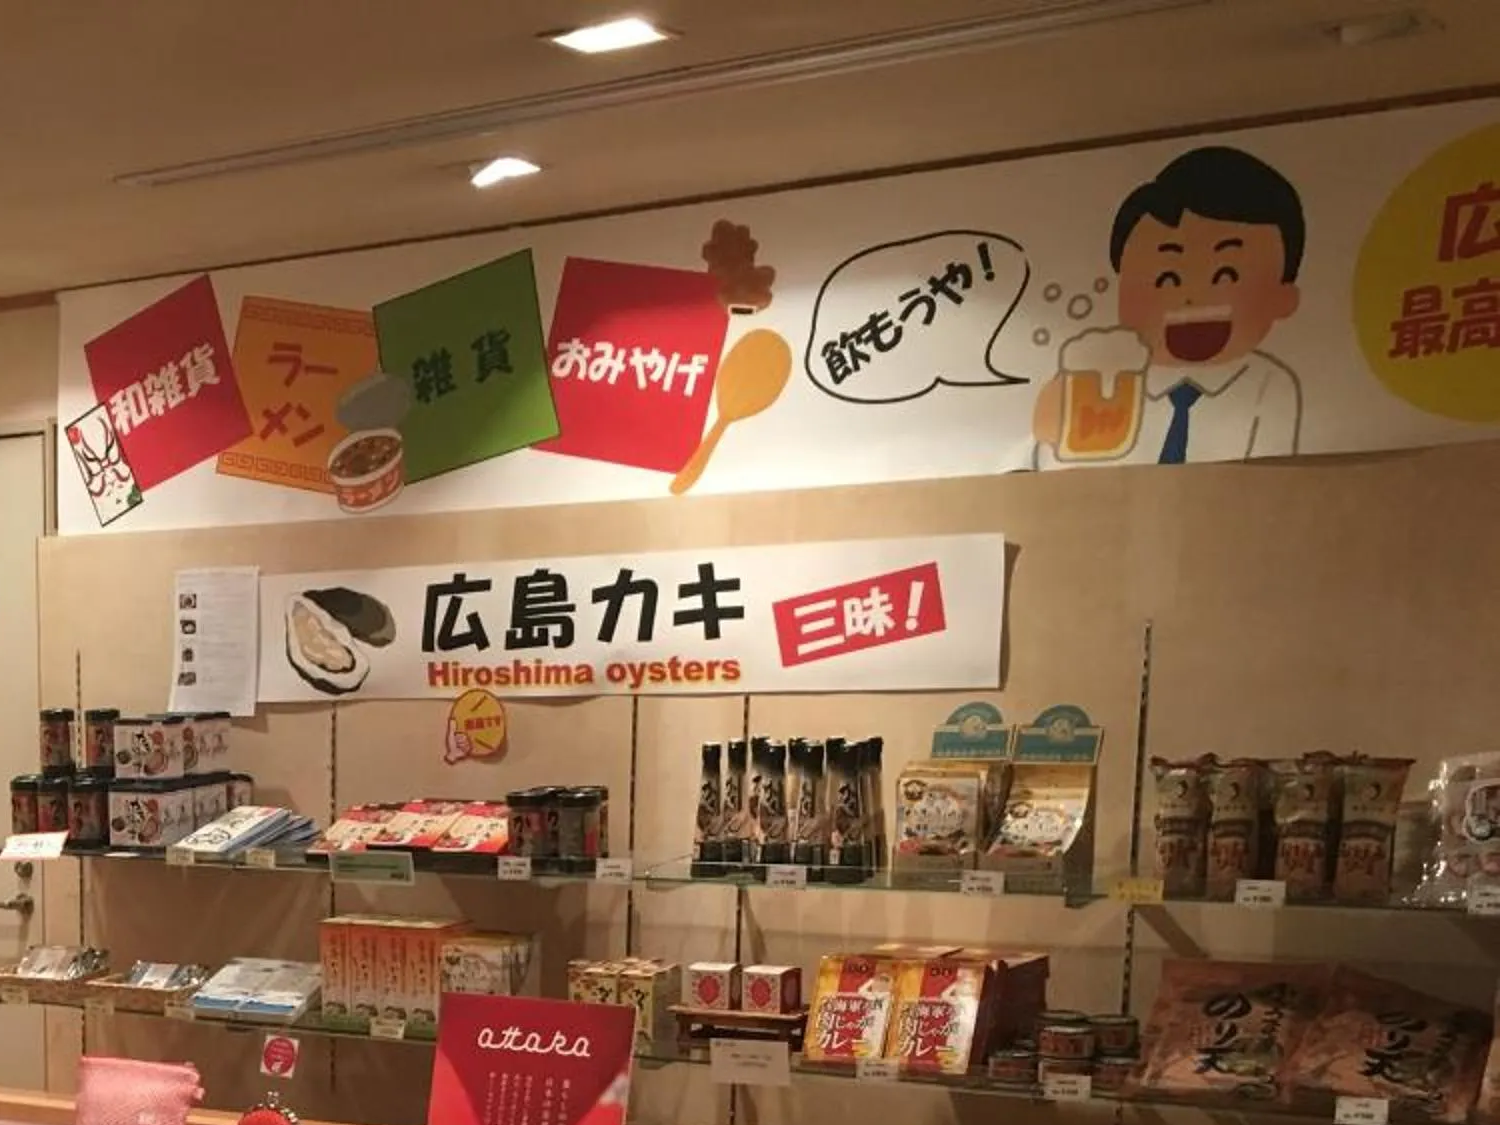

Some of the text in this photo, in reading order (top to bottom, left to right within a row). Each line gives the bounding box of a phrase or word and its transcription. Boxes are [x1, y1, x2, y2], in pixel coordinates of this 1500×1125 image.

[822, 243, 995, 386] 飲もうや!
[109, 341, 222, 436] 和雑貨
[552, 336, 710, 399] おみやげ
[421, 562, 746, 654] 広島カキ
[427, 655, 742, 689] Hiroshima oysters
